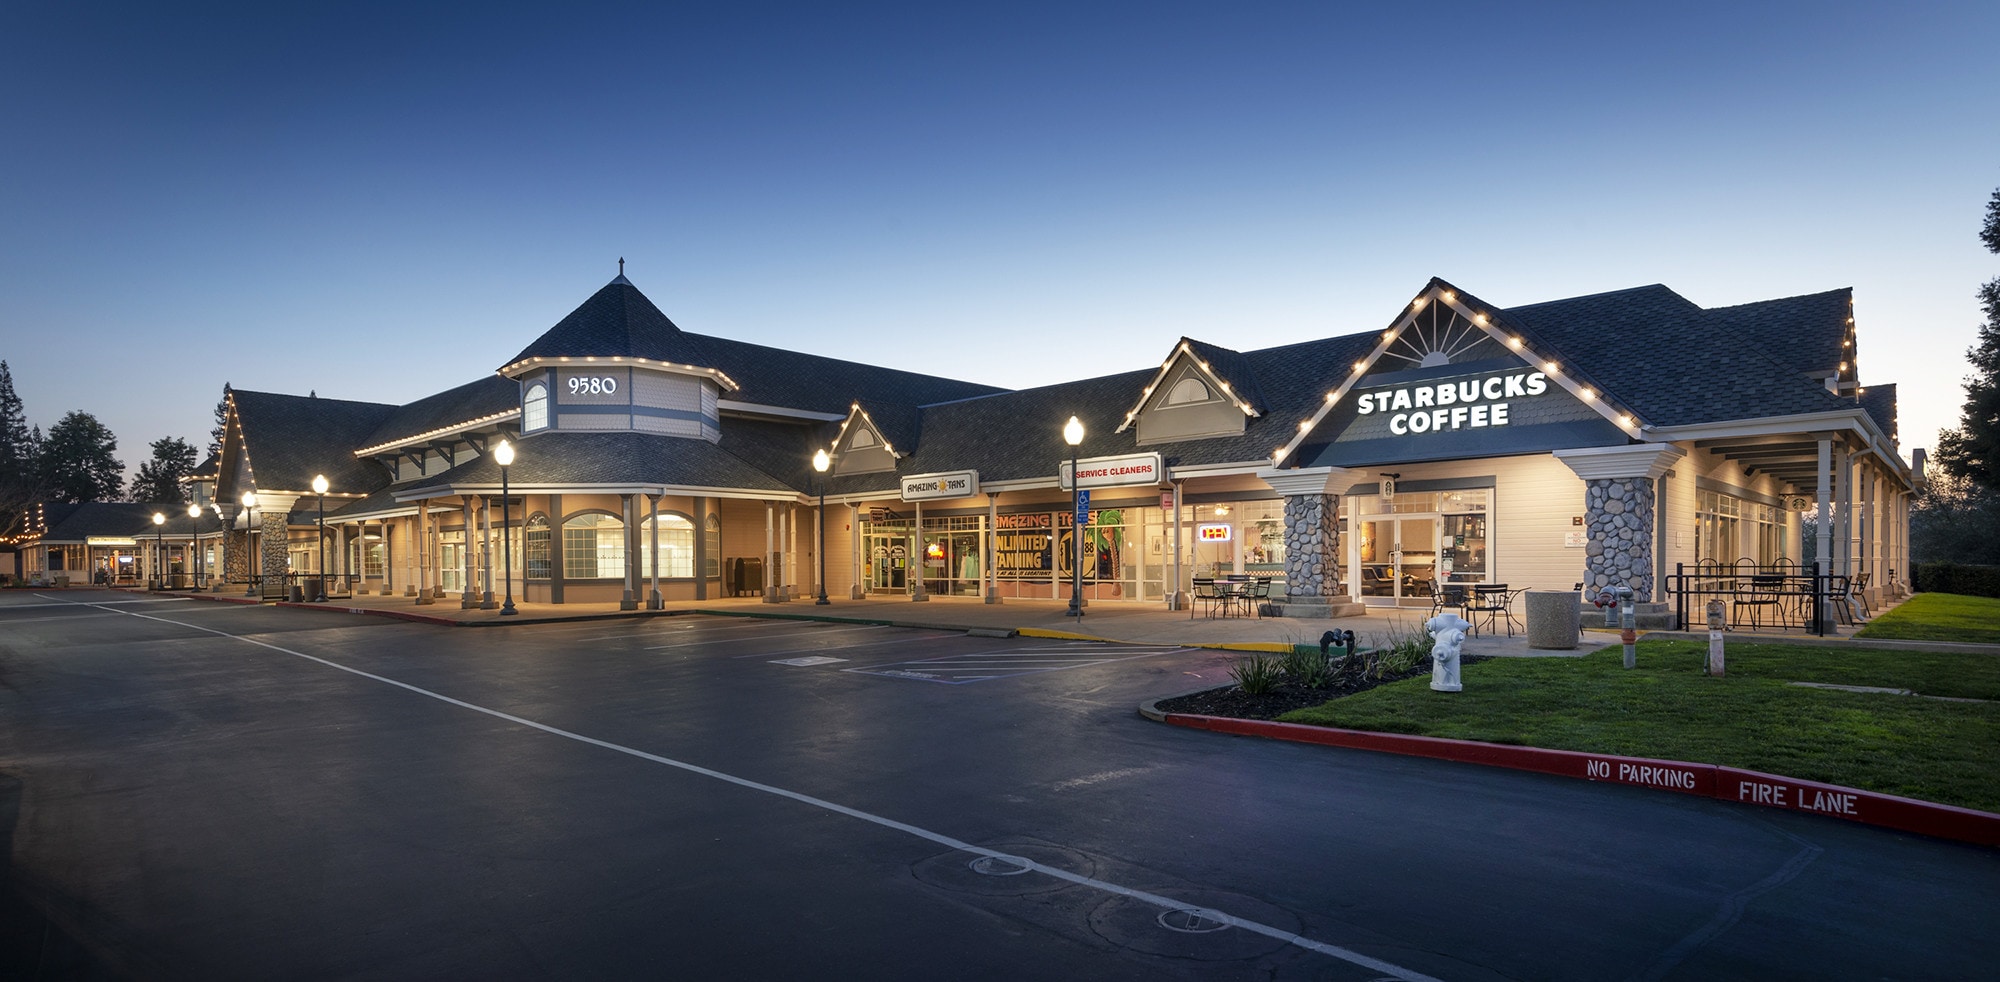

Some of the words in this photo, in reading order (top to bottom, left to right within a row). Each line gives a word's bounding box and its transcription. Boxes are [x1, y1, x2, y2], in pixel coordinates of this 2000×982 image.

[568, 377, 617, 395] 9580
[1357, 372, 1547, 415] STARBUCKS
[1389, 403, 1509, 435] COFFEE
[1075, 468, 1108, 479] SERVICE
[1109, 464, 1153, 476] CLEANERS
[907, 481, 938, 493] AMAZING
[947, 479, 966, 490] TANS
[1201, 527, 1229, 540] OPEN
[1084, 541, 1095, 553] 88
[1587, 760, 1610, 779] NO
[1619, 763, 1695, 790] PARKING
[1739, 781, 1787, 806] FIRE
[1798, 788, 1858, 815] LANE
